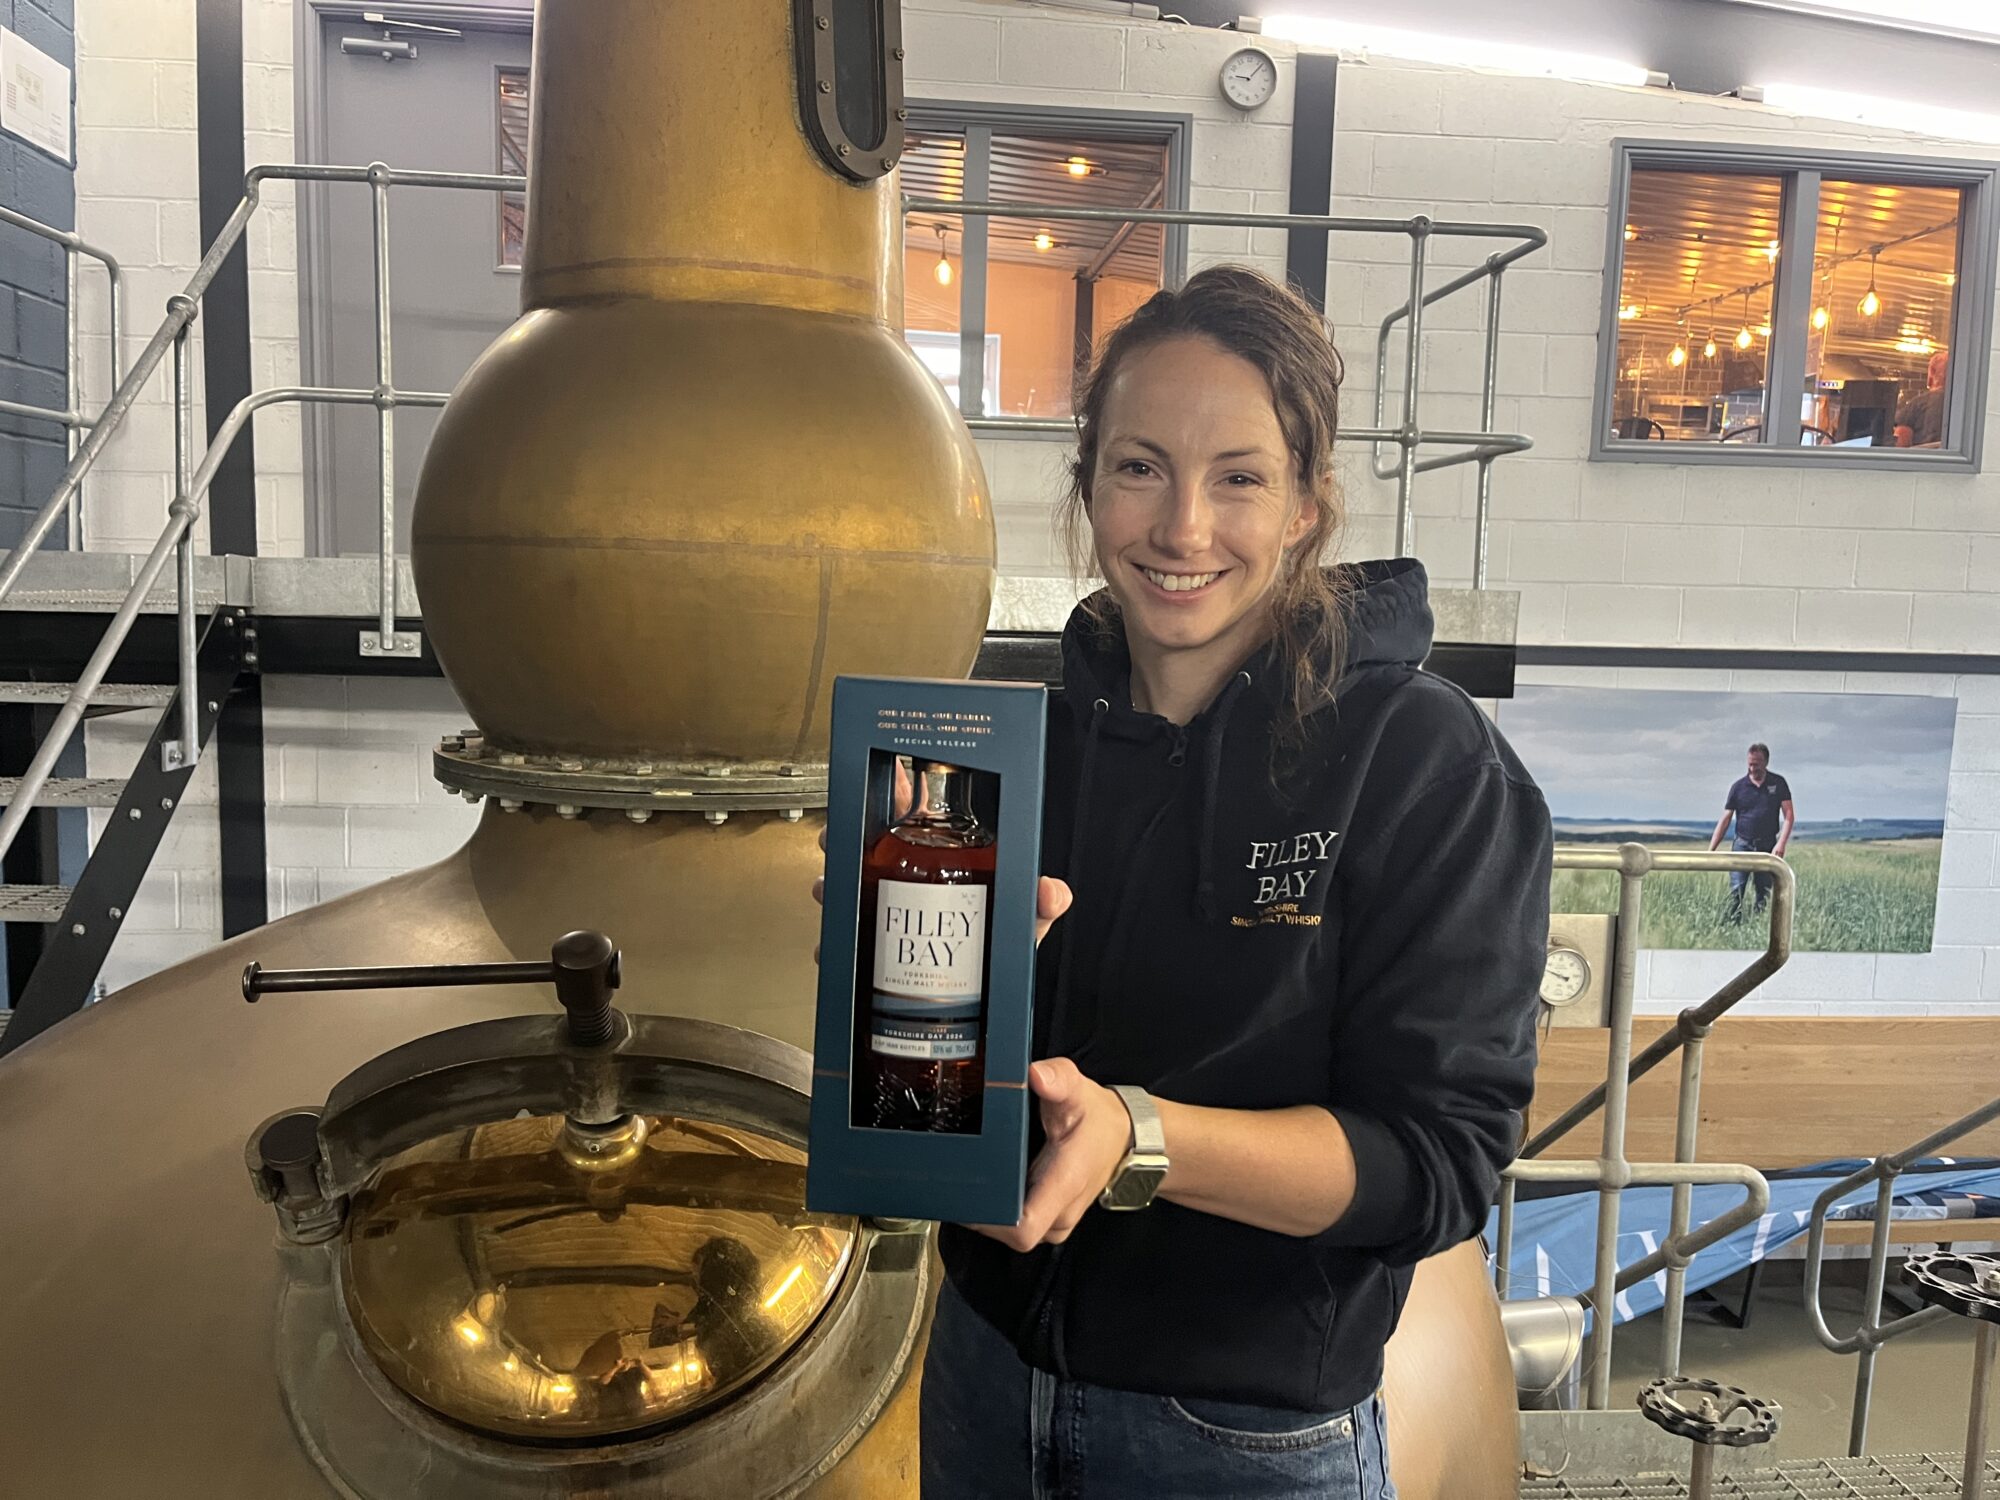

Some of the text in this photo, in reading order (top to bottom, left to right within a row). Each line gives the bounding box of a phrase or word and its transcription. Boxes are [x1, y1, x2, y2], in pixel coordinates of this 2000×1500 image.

[932, 712, 952, 720] OUR
[894, 737, 932, 745] SPECIAL
[1246, 830, 1340, 869] FILEY
[1253, 869, 1317, 904] BAY
[885, 906, 979, 937] FILEY
[897, 938, 963, 967] BAY
[885, 976, 910, 986] SINGLE
[913, 980, 934, 988] MALT
[884, 1028, 925, 1039] YORKSHIRE
